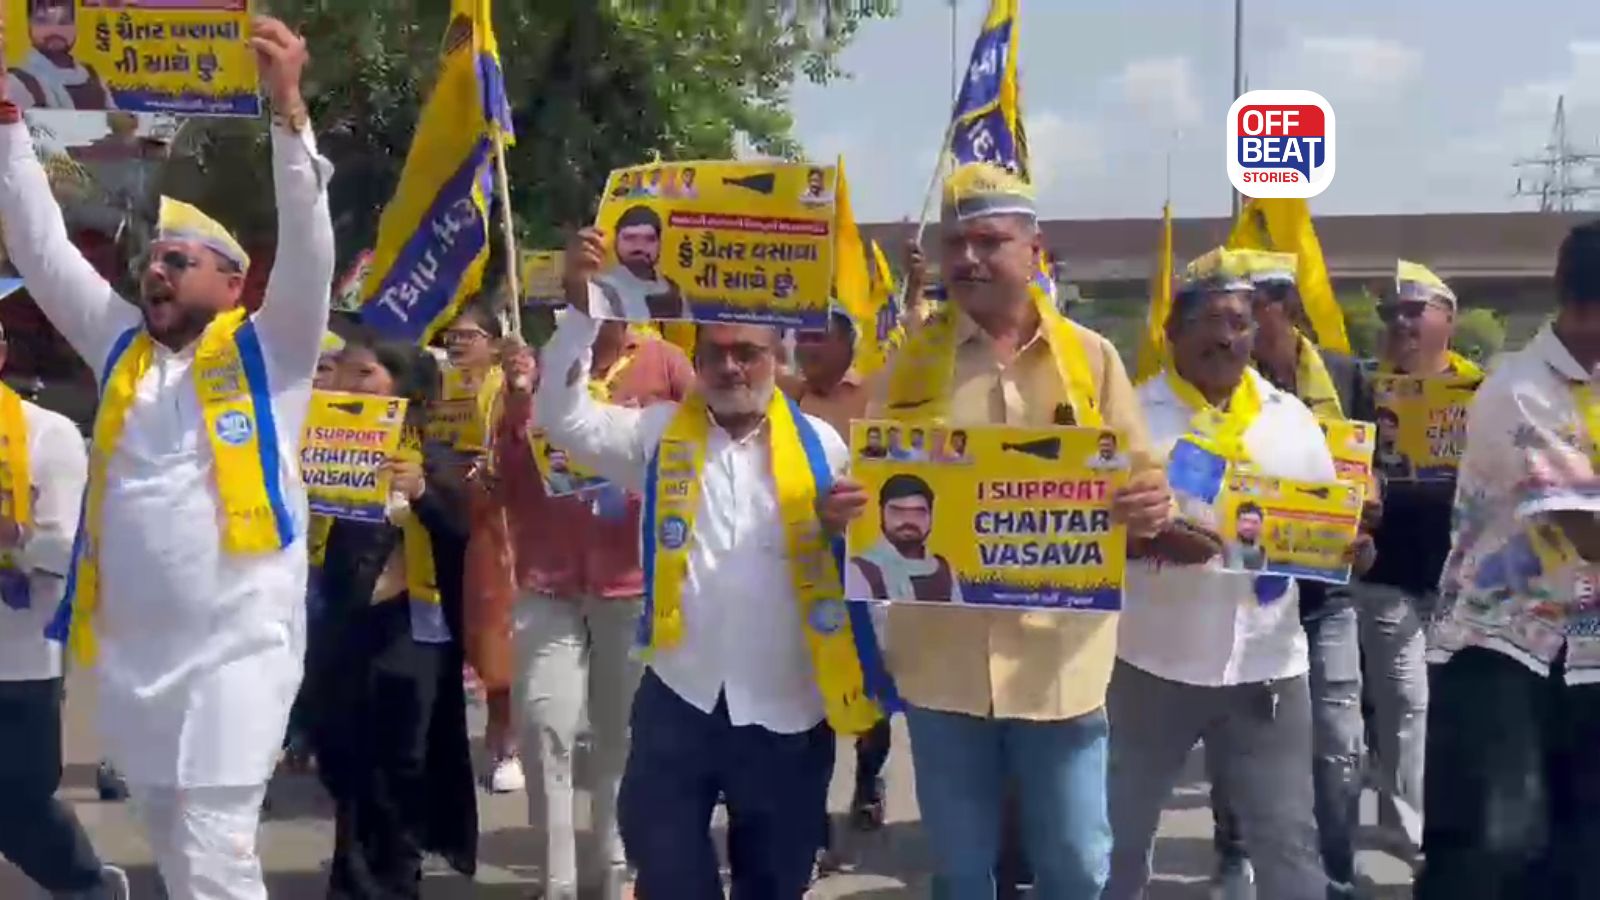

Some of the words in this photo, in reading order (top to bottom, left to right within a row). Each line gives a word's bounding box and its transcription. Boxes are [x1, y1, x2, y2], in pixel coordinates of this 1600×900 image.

[315, 427, 387, 443] SUPPORT
[302, 469, 376, 488] VASAVA
[978, 481, 984, 500] I
[989, 480, 1108, 500] SUPPORT
[974, 509, 1110, 534] CHAITAR
[980, 541, 1103, 566] VASAVA
